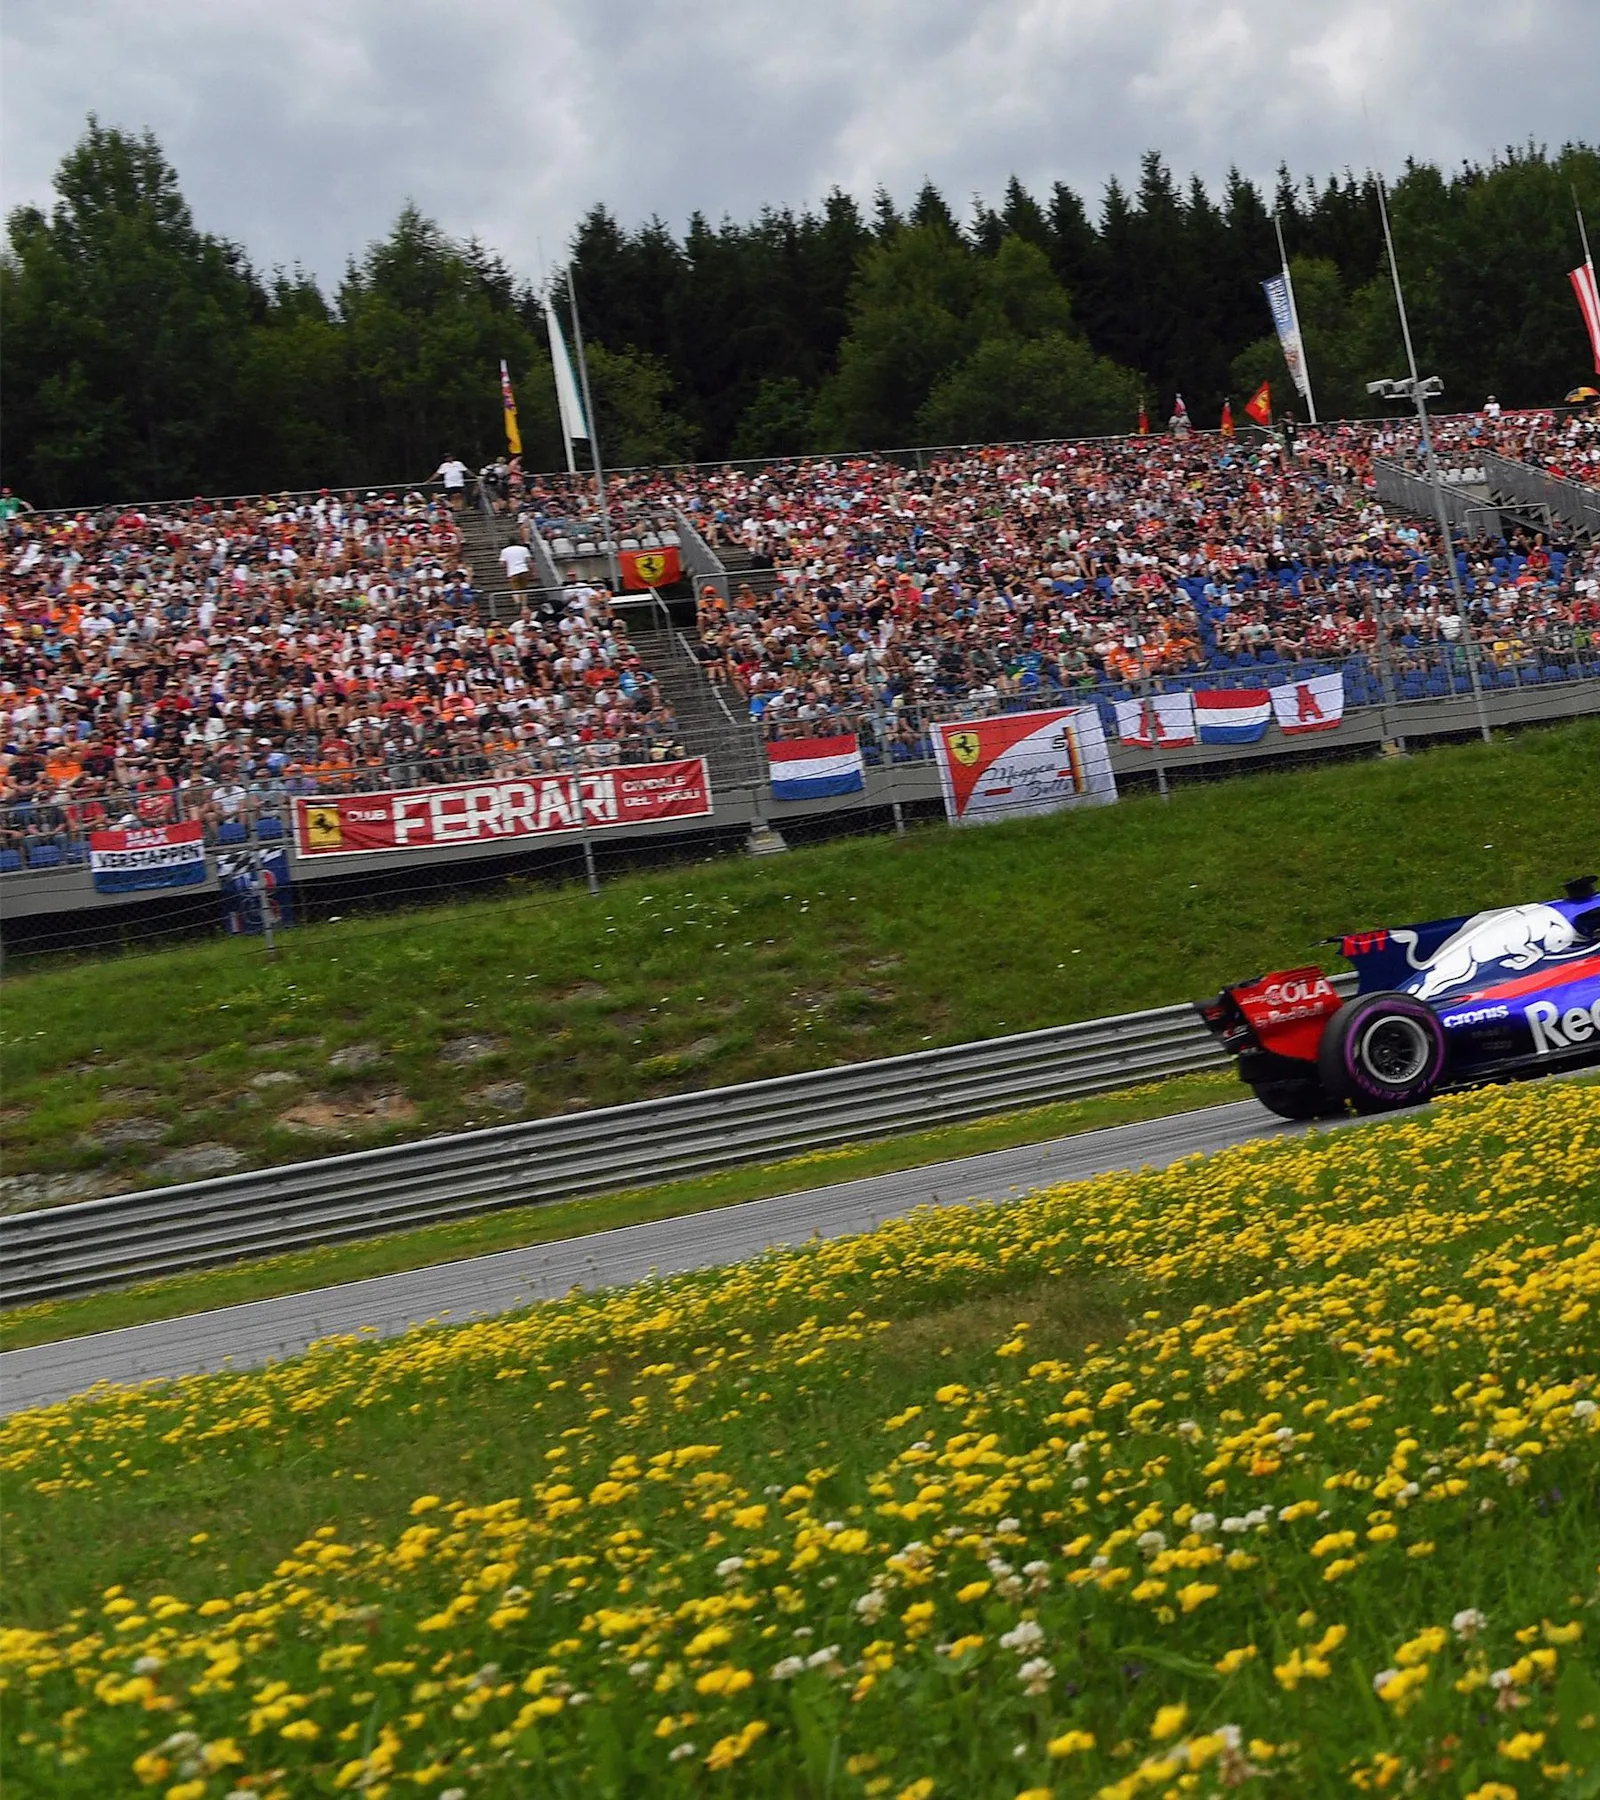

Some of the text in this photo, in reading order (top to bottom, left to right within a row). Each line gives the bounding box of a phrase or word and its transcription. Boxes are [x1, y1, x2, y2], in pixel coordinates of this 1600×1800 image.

[391, 774, 619, 844] FERRARI
[125, 828, 169, 849] MAX
[1264, 977, 1333, 1006] COLA
